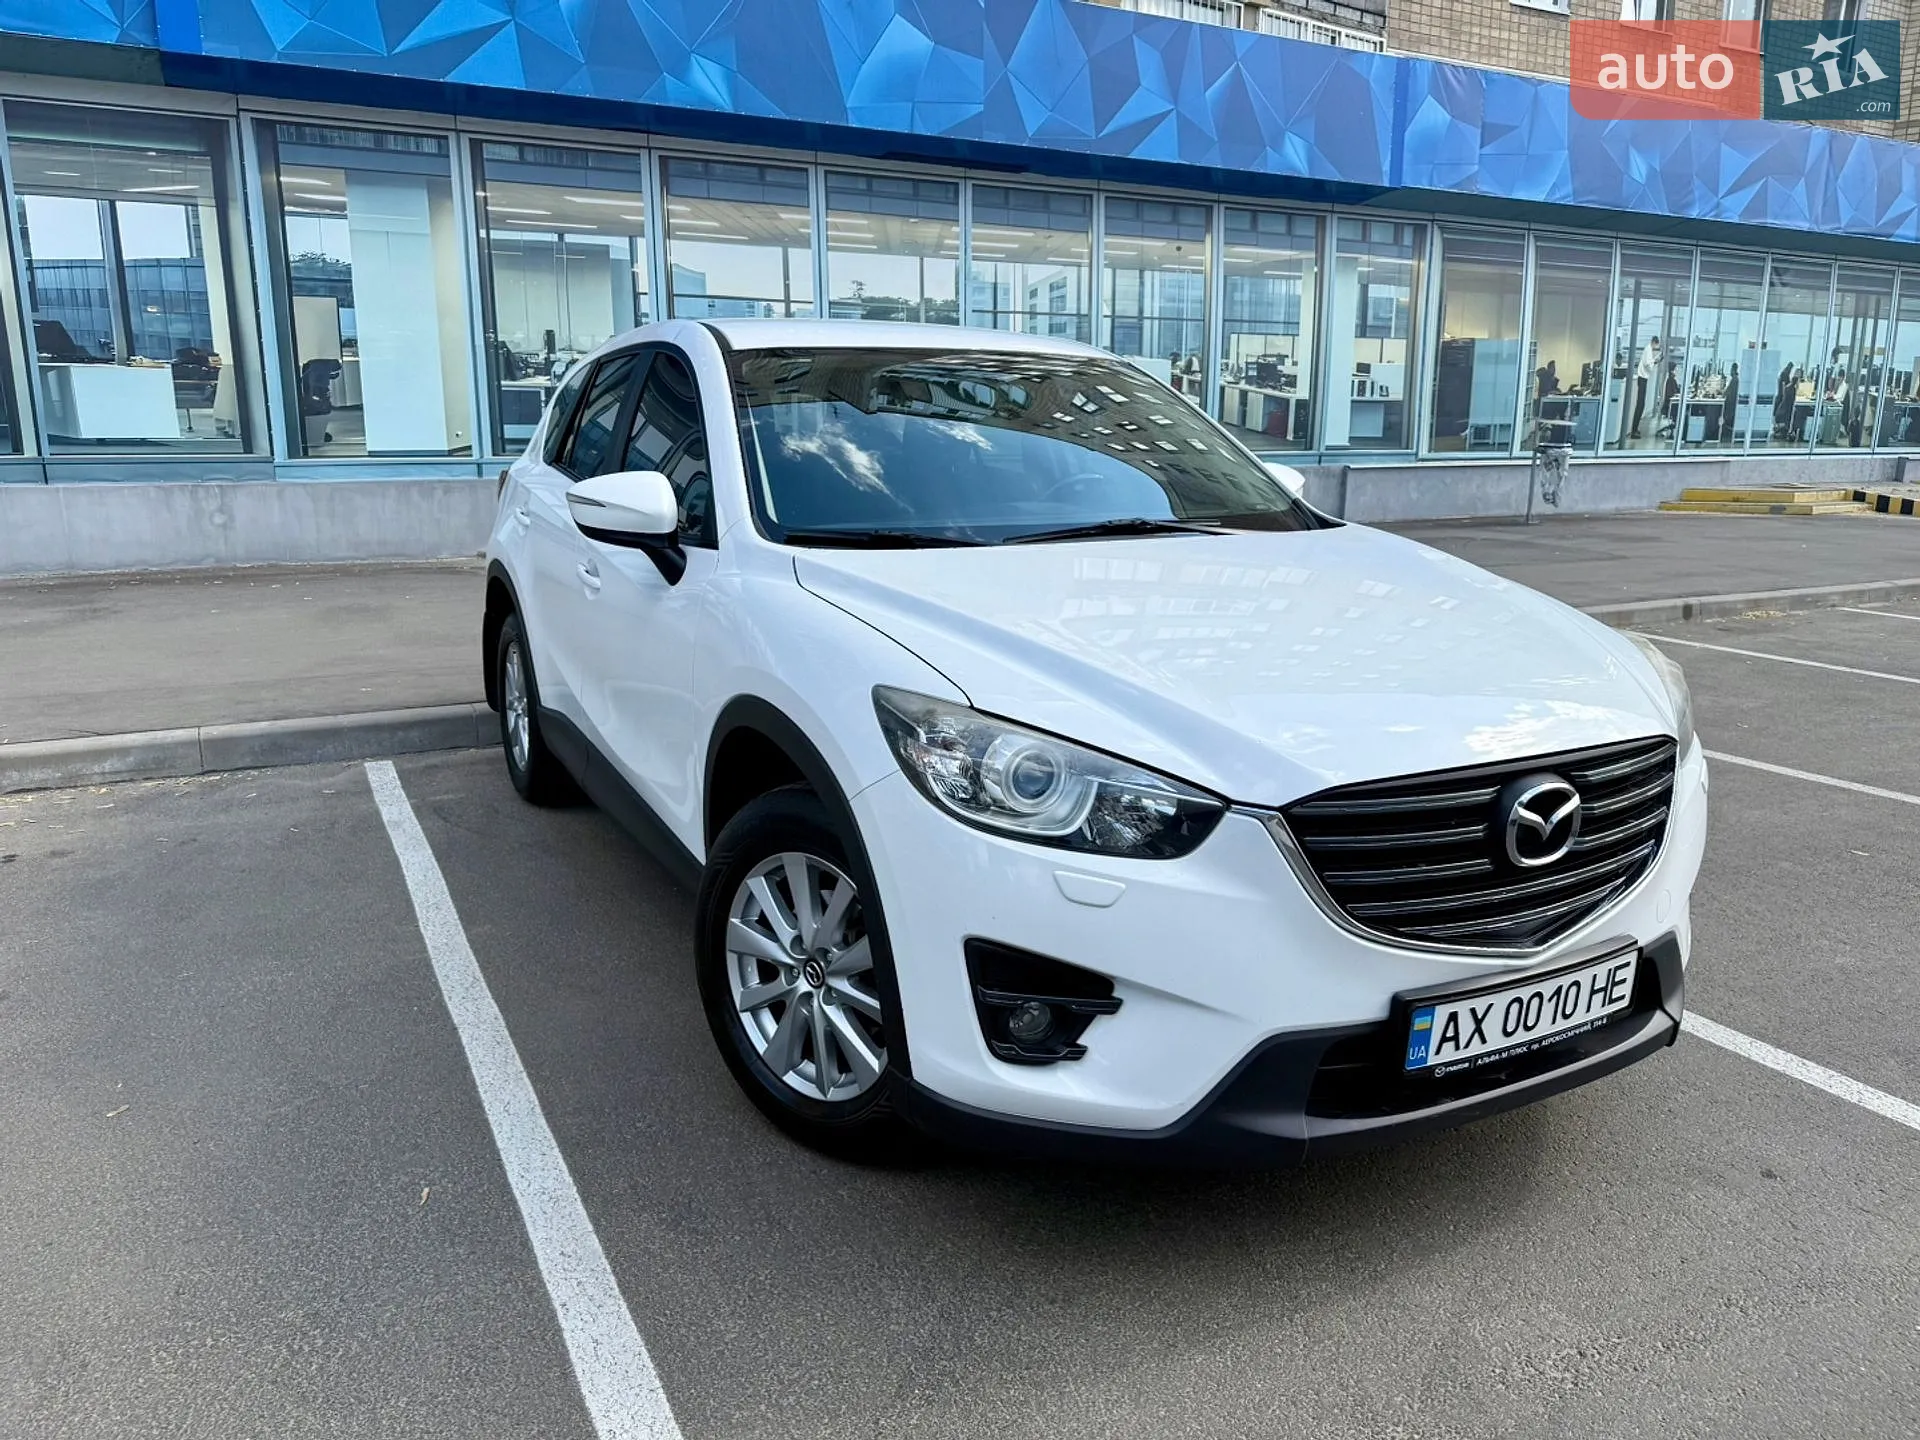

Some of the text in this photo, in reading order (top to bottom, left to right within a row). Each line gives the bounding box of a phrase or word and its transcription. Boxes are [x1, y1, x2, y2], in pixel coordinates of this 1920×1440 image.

[1434, 962, 1631, 1056] AX 0010 HE
[1409, 1045, 1427, 1060] UA
